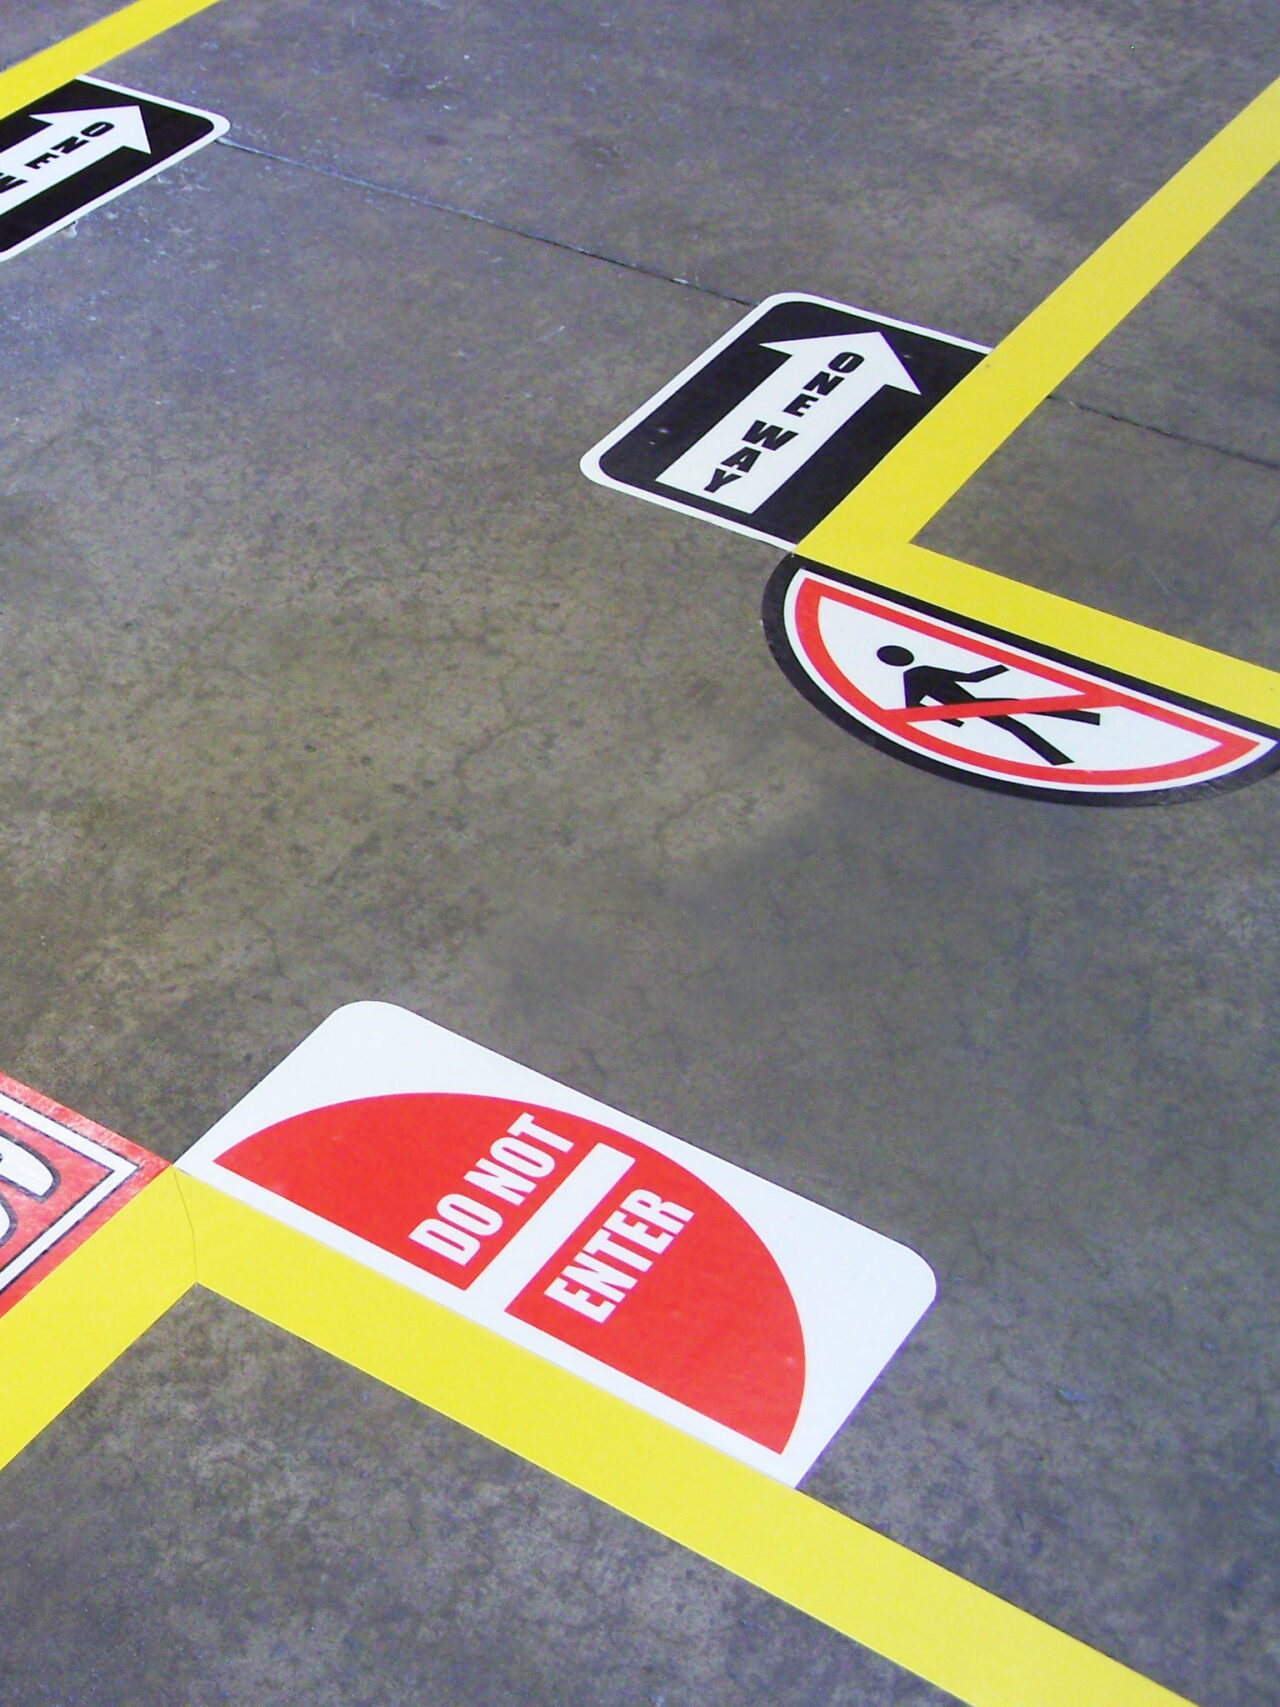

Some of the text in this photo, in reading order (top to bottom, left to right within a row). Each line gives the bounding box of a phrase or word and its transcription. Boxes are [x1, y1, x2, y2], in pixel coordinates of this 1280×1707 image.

[24, 121, 115, 170] ONE
[703, 351, 865, 494] ONE WAY
[409, 1111, 575, 1267] DO NOT
[543, 1187, 695, 1325] ENTER
